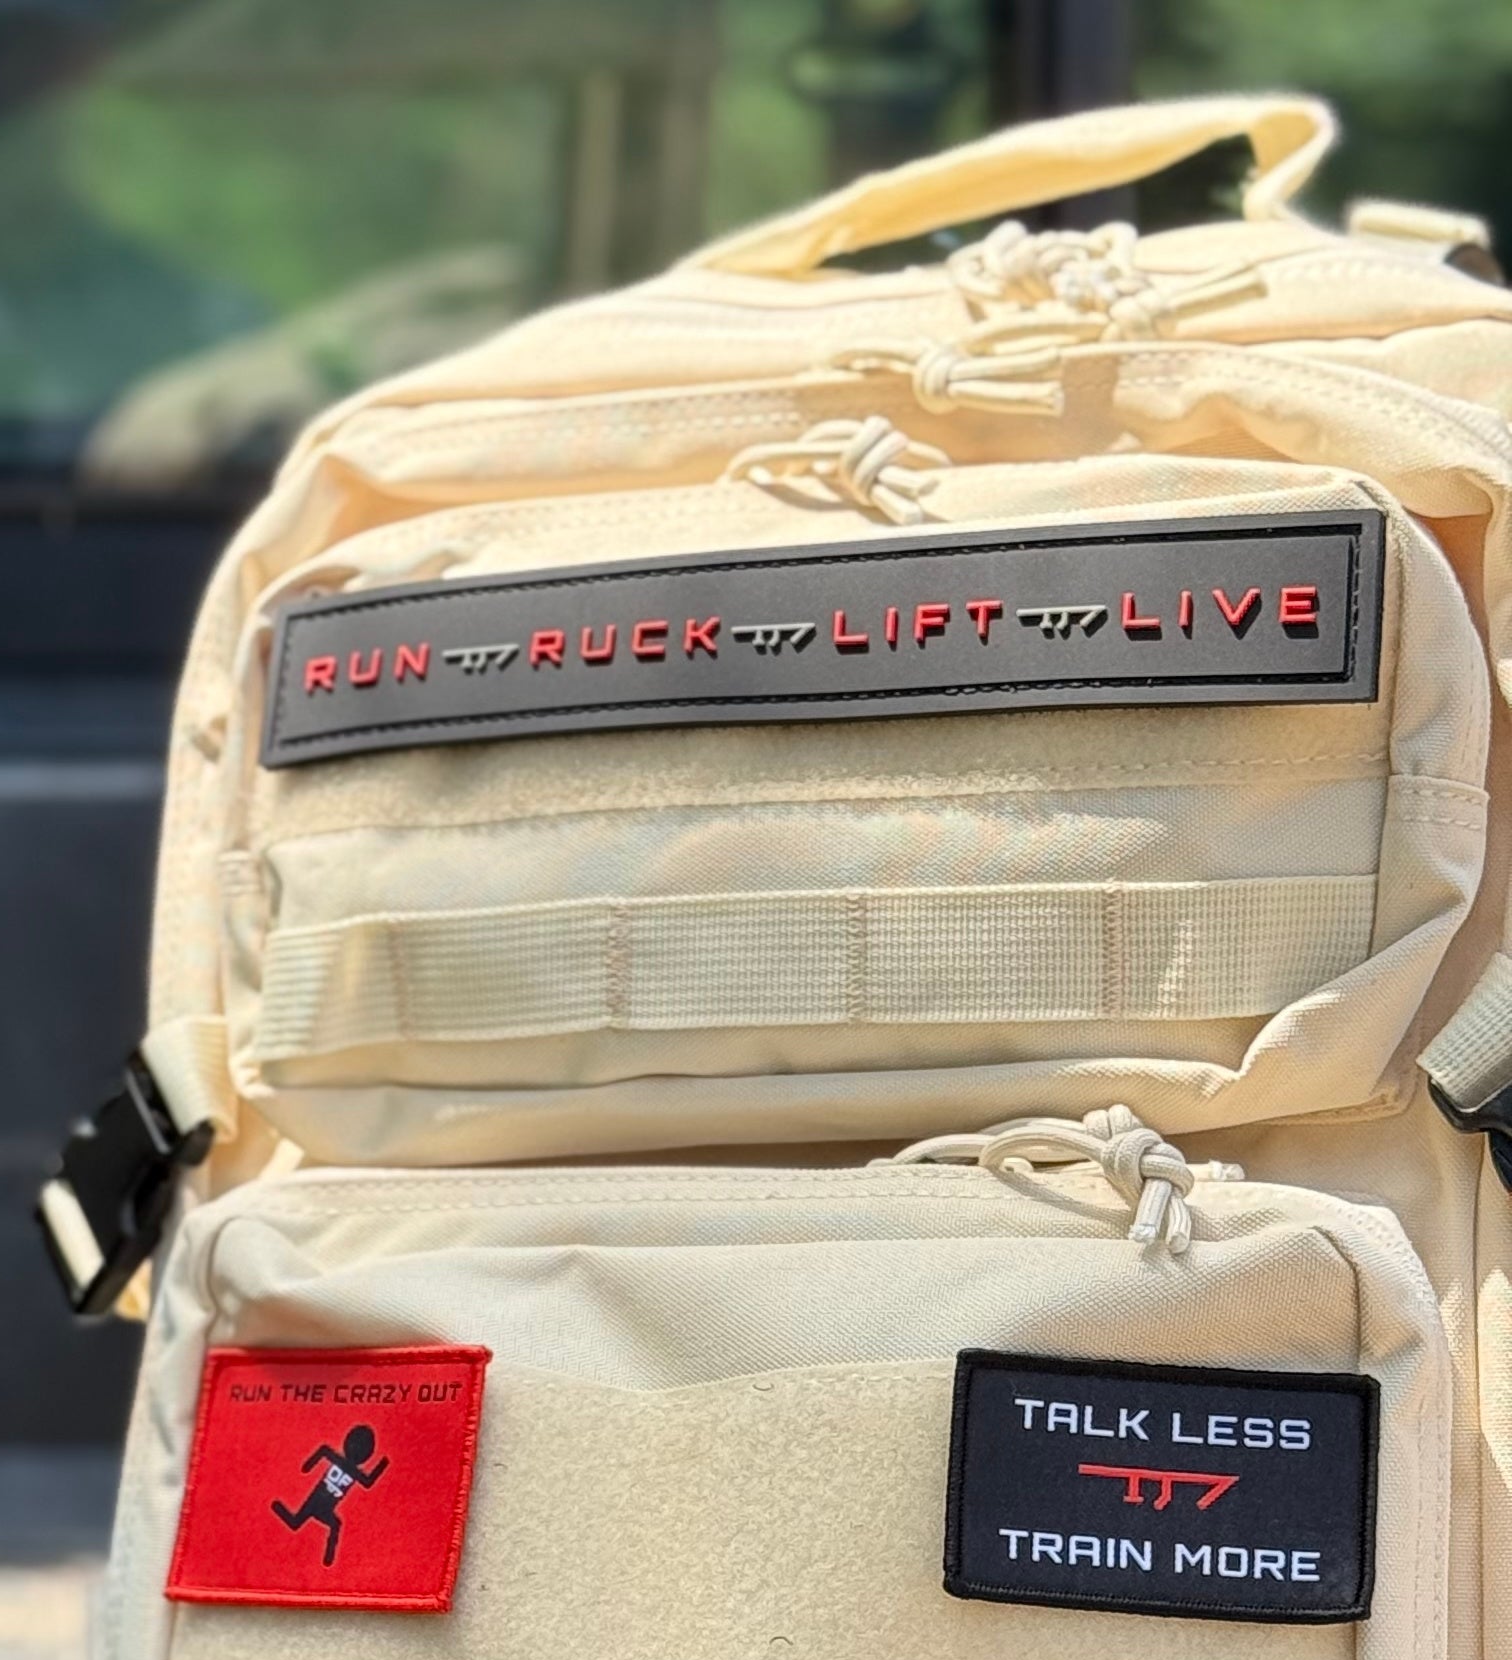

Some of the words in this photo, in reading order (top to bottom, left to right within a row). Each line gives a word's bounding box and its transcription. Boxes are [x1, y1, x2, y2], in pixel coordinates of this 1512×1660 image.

[303, 643, 431, 693] RUN
[528, 616, 720, 666] RUCK
[832, 600, 1002, 647] LIFT
[1120, 585, 1317, 630] LIVE
[229, 1384, 273, 1403] RUN
[280, 1383, 328, 1403] THE
[333, 1383, 413, 1405] CRAZY
[417, 1380, 464, 1403] OUT
[1013, 1397, 1151, 1441] TALK
[1171, 1410, 1313, 1451] LESS
[998, 1527, 1153, 1572] TRAIN
[1173, 1542, 1322, 1582] MORE
